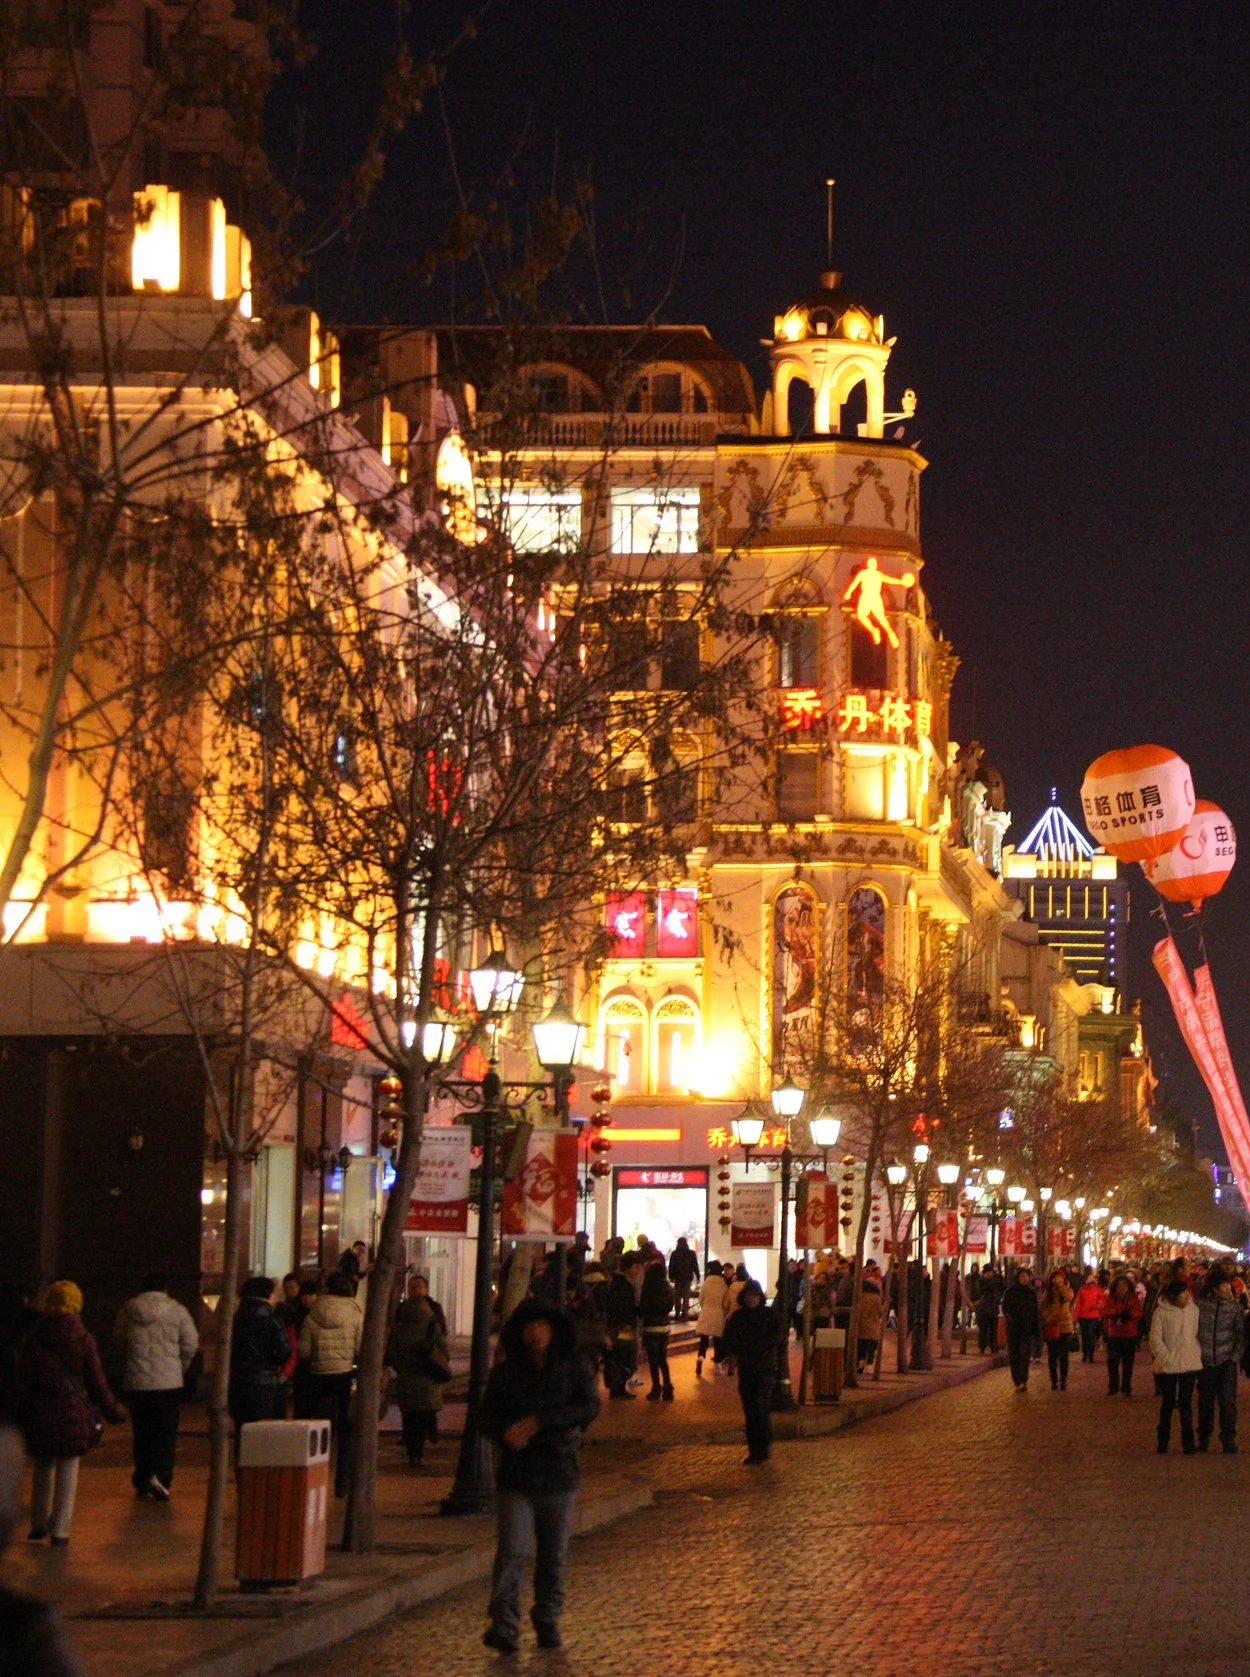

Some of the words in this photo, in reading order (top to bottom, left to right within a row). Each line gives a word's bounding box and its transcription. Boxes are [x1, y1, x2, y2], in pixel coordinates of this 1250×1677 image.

[784, 690, 932, 736] 乔丹体育
[1112, 809, 1164, 827] SPORTS
[707, 1128, 787, 1148] 乔育
